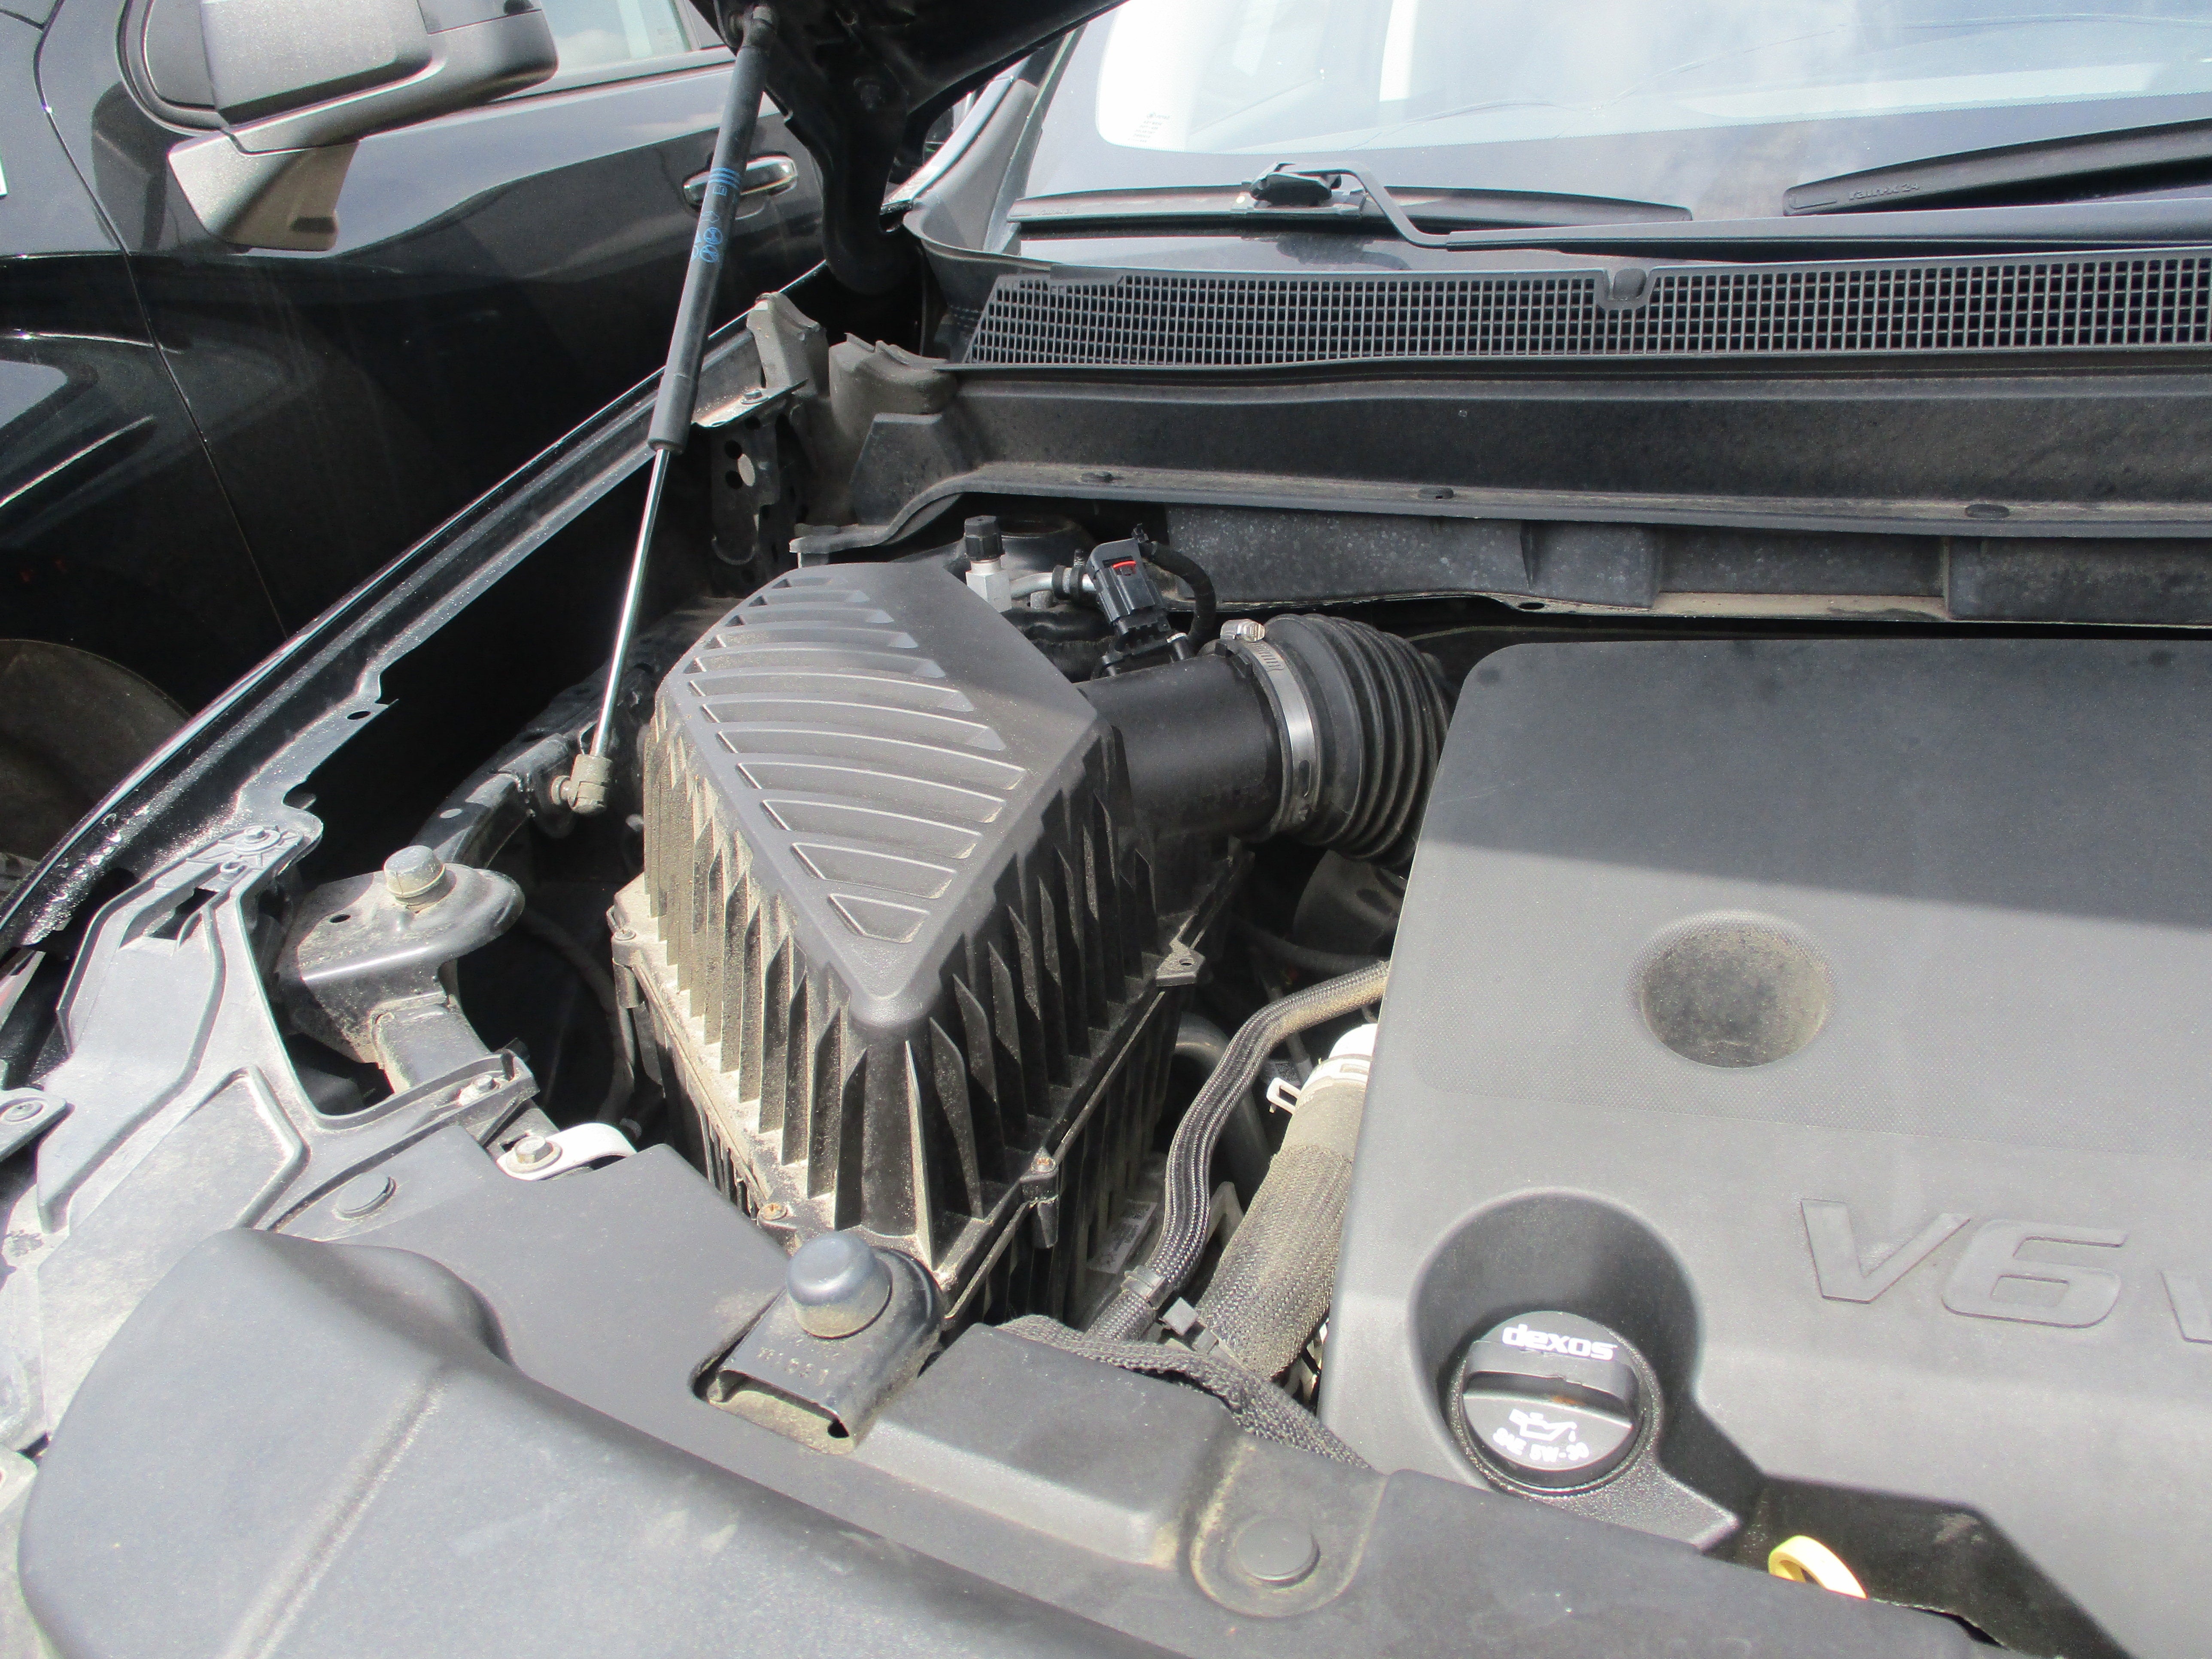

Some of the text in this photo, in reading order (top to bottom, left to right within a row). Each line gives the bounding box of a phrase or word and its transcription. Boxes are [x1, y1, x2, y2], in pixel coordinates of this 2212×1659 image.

[1801, 1198, 2129, 1329] V6
[1502, 1323, 1618, 1361] dexos
[1529, 1442, 1590, 1462] 5W-30
